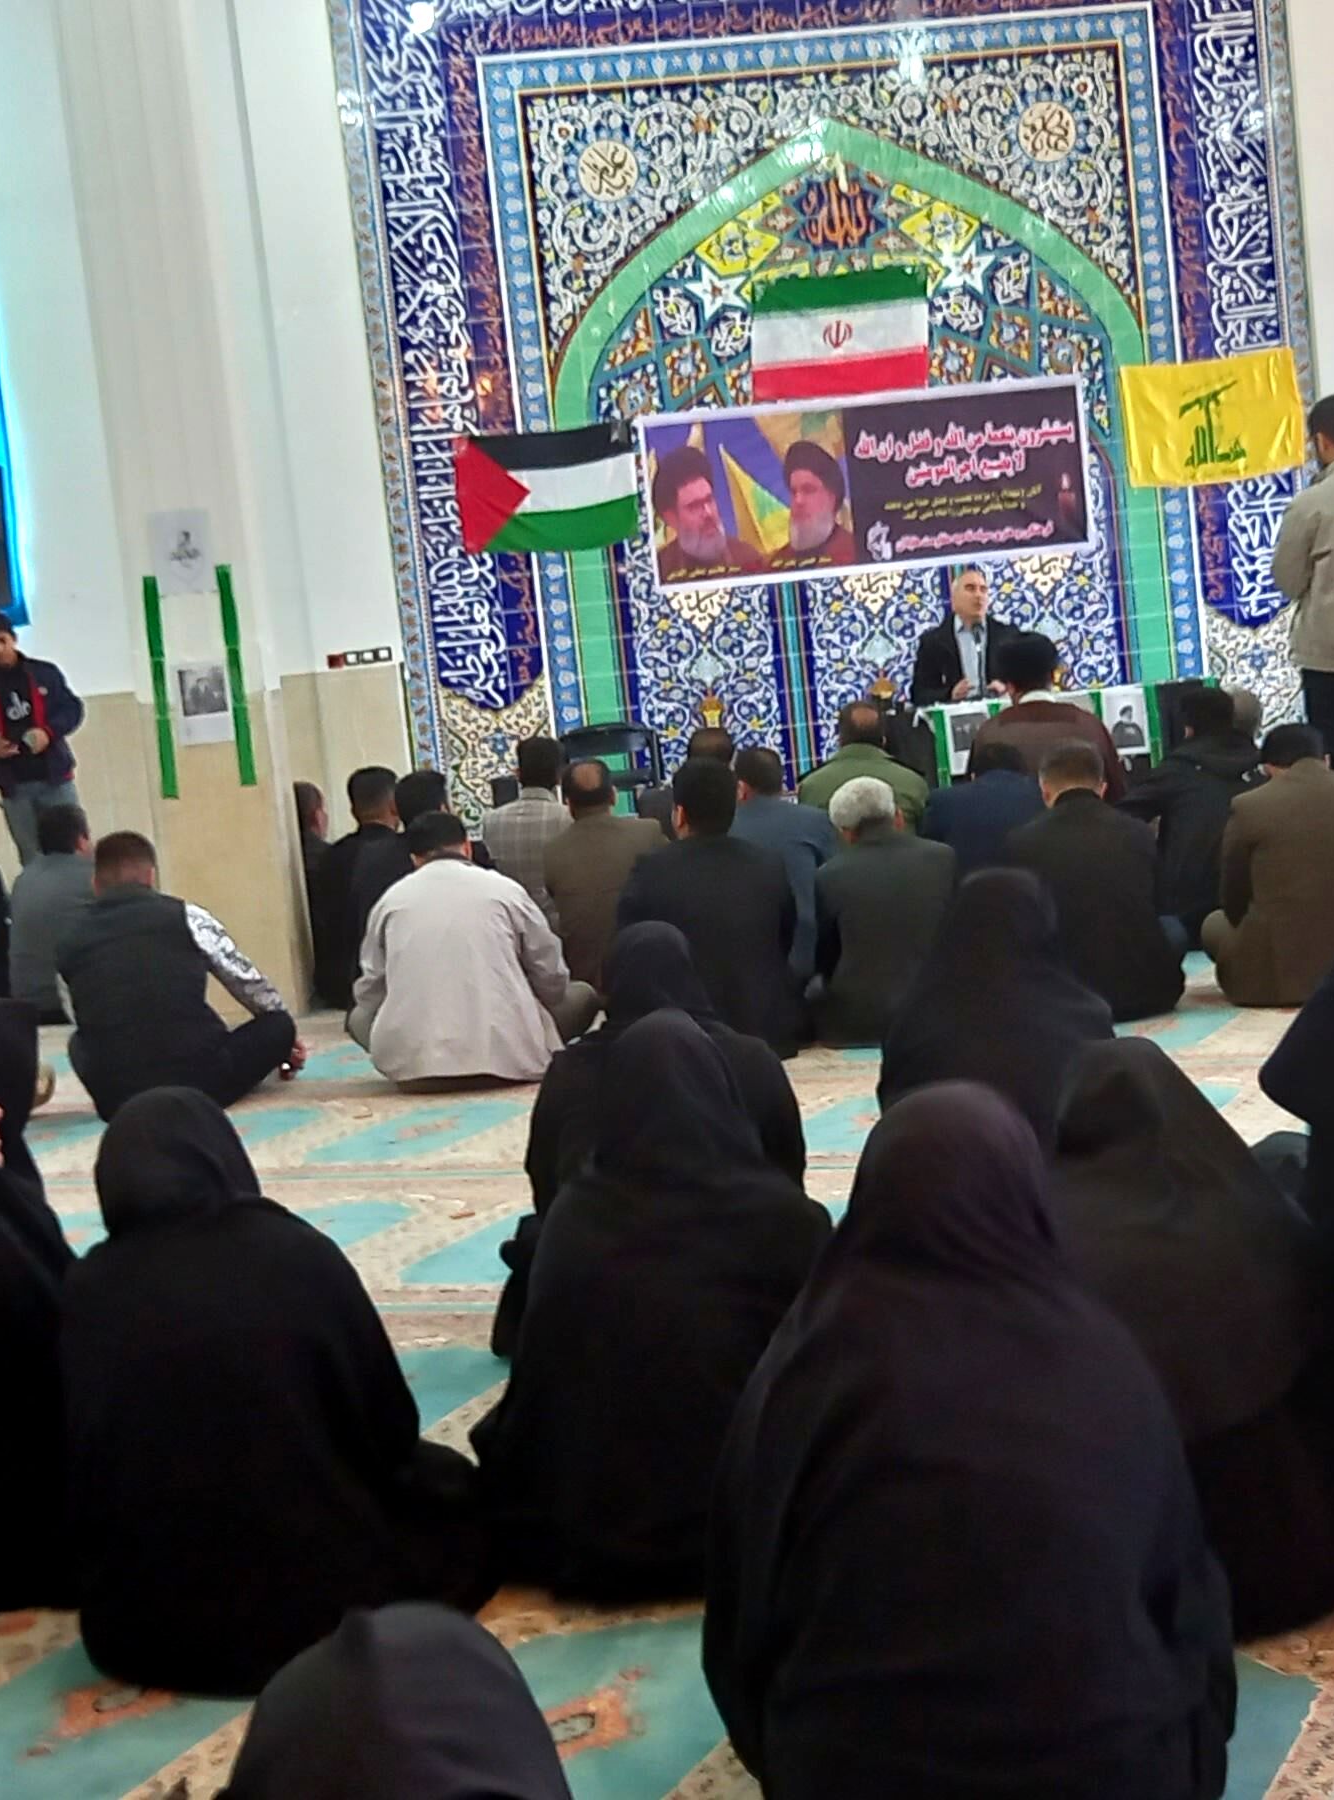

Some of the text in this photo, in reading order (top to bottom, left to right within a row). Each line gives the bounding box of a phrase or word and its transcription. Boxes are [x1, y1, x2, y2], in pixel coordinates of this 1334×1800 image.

[854, 428, 878, 460] الله
[907, 428, 933, 457] فضل
[944, 421, 966, 449] الله
[967, 431, 984, 452] من
[895, 440, 905, 460] و
[933, 436, 944, 457] و
[1014, 450, 1026, 471] لا
